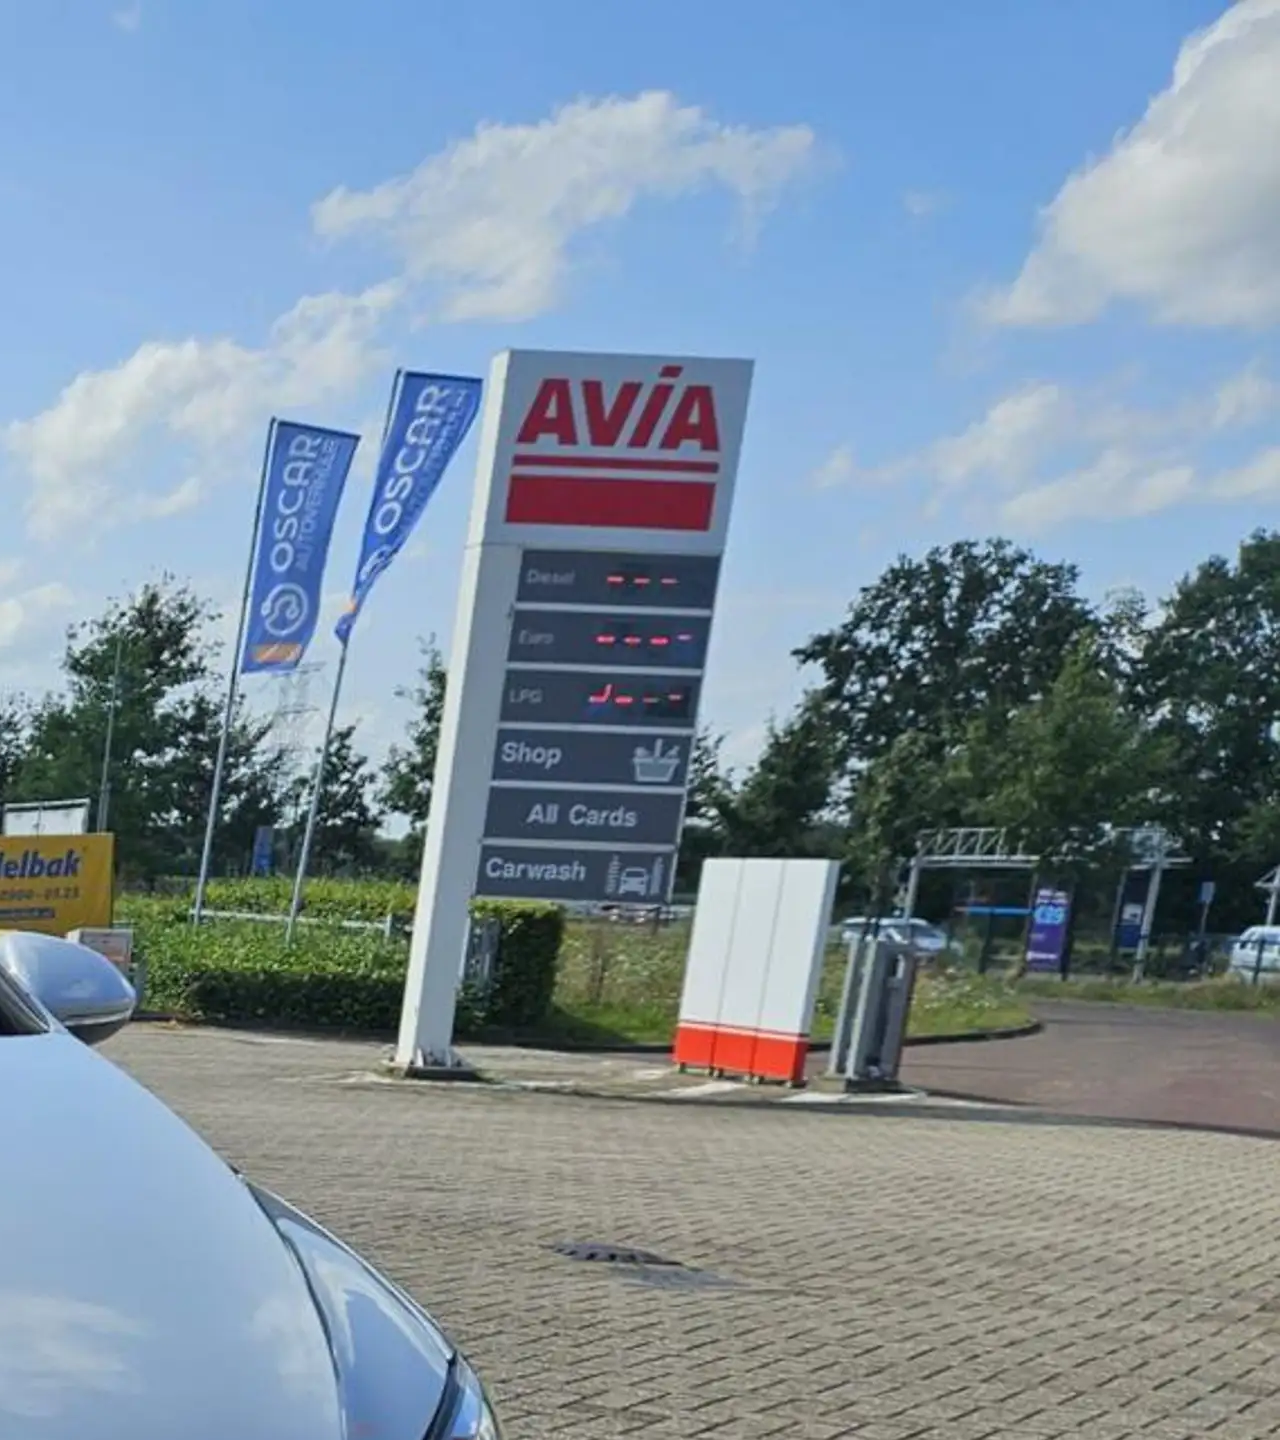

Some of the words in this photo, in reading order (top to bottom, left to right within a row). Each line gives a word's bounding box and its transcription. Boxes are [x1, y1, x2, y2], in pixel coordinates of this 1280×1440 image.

[375, 385, 450, 535] OSCAR
[269, 433, 322, 572] OSCAR
[501, 741, 563, 770] Shop
[526, 804, 558, 824] All
[568, 804, 638, 828] Cards
[485, 857, 588, 882] Carwash
